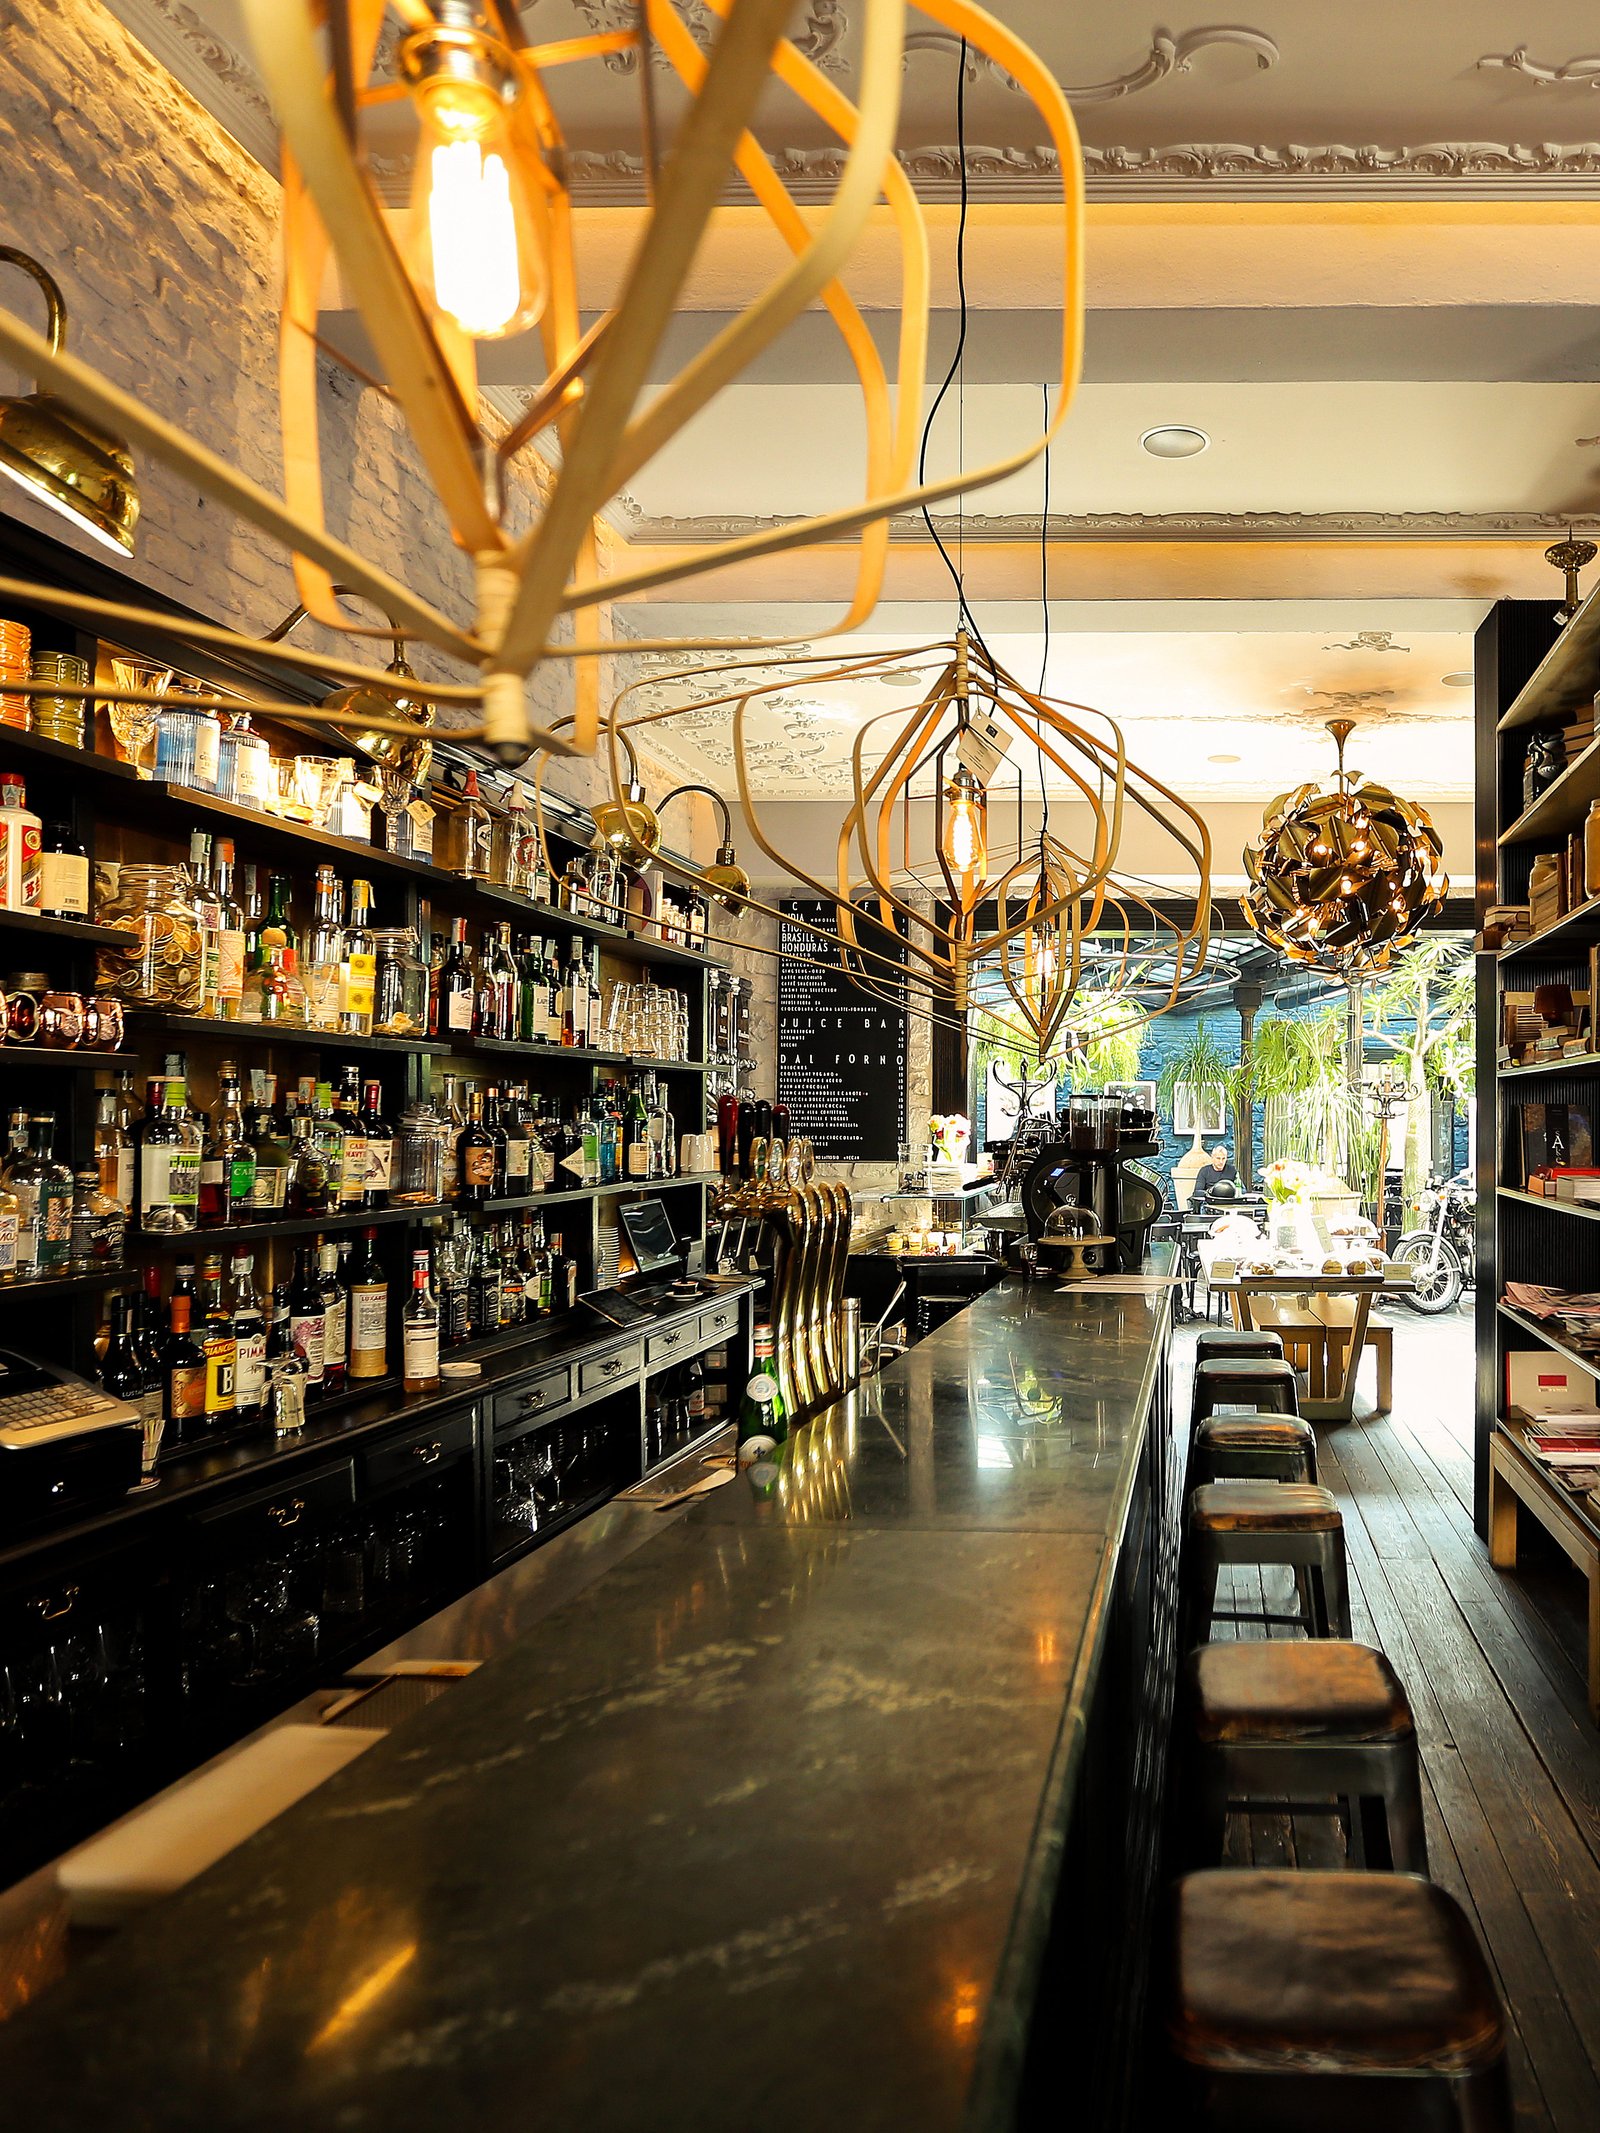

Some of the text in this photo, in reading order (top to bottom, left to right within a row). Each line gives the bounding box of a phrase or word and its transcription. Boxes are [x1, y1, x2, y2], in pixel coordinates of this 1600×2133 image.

[781, 932, 815, 942] BRASILE
[781, 942, 829, 952] HONDURAS
[780, 1018, 904, 1029] JUICE BAR
[780, 1053, 904, 1065] DAL FORNO
